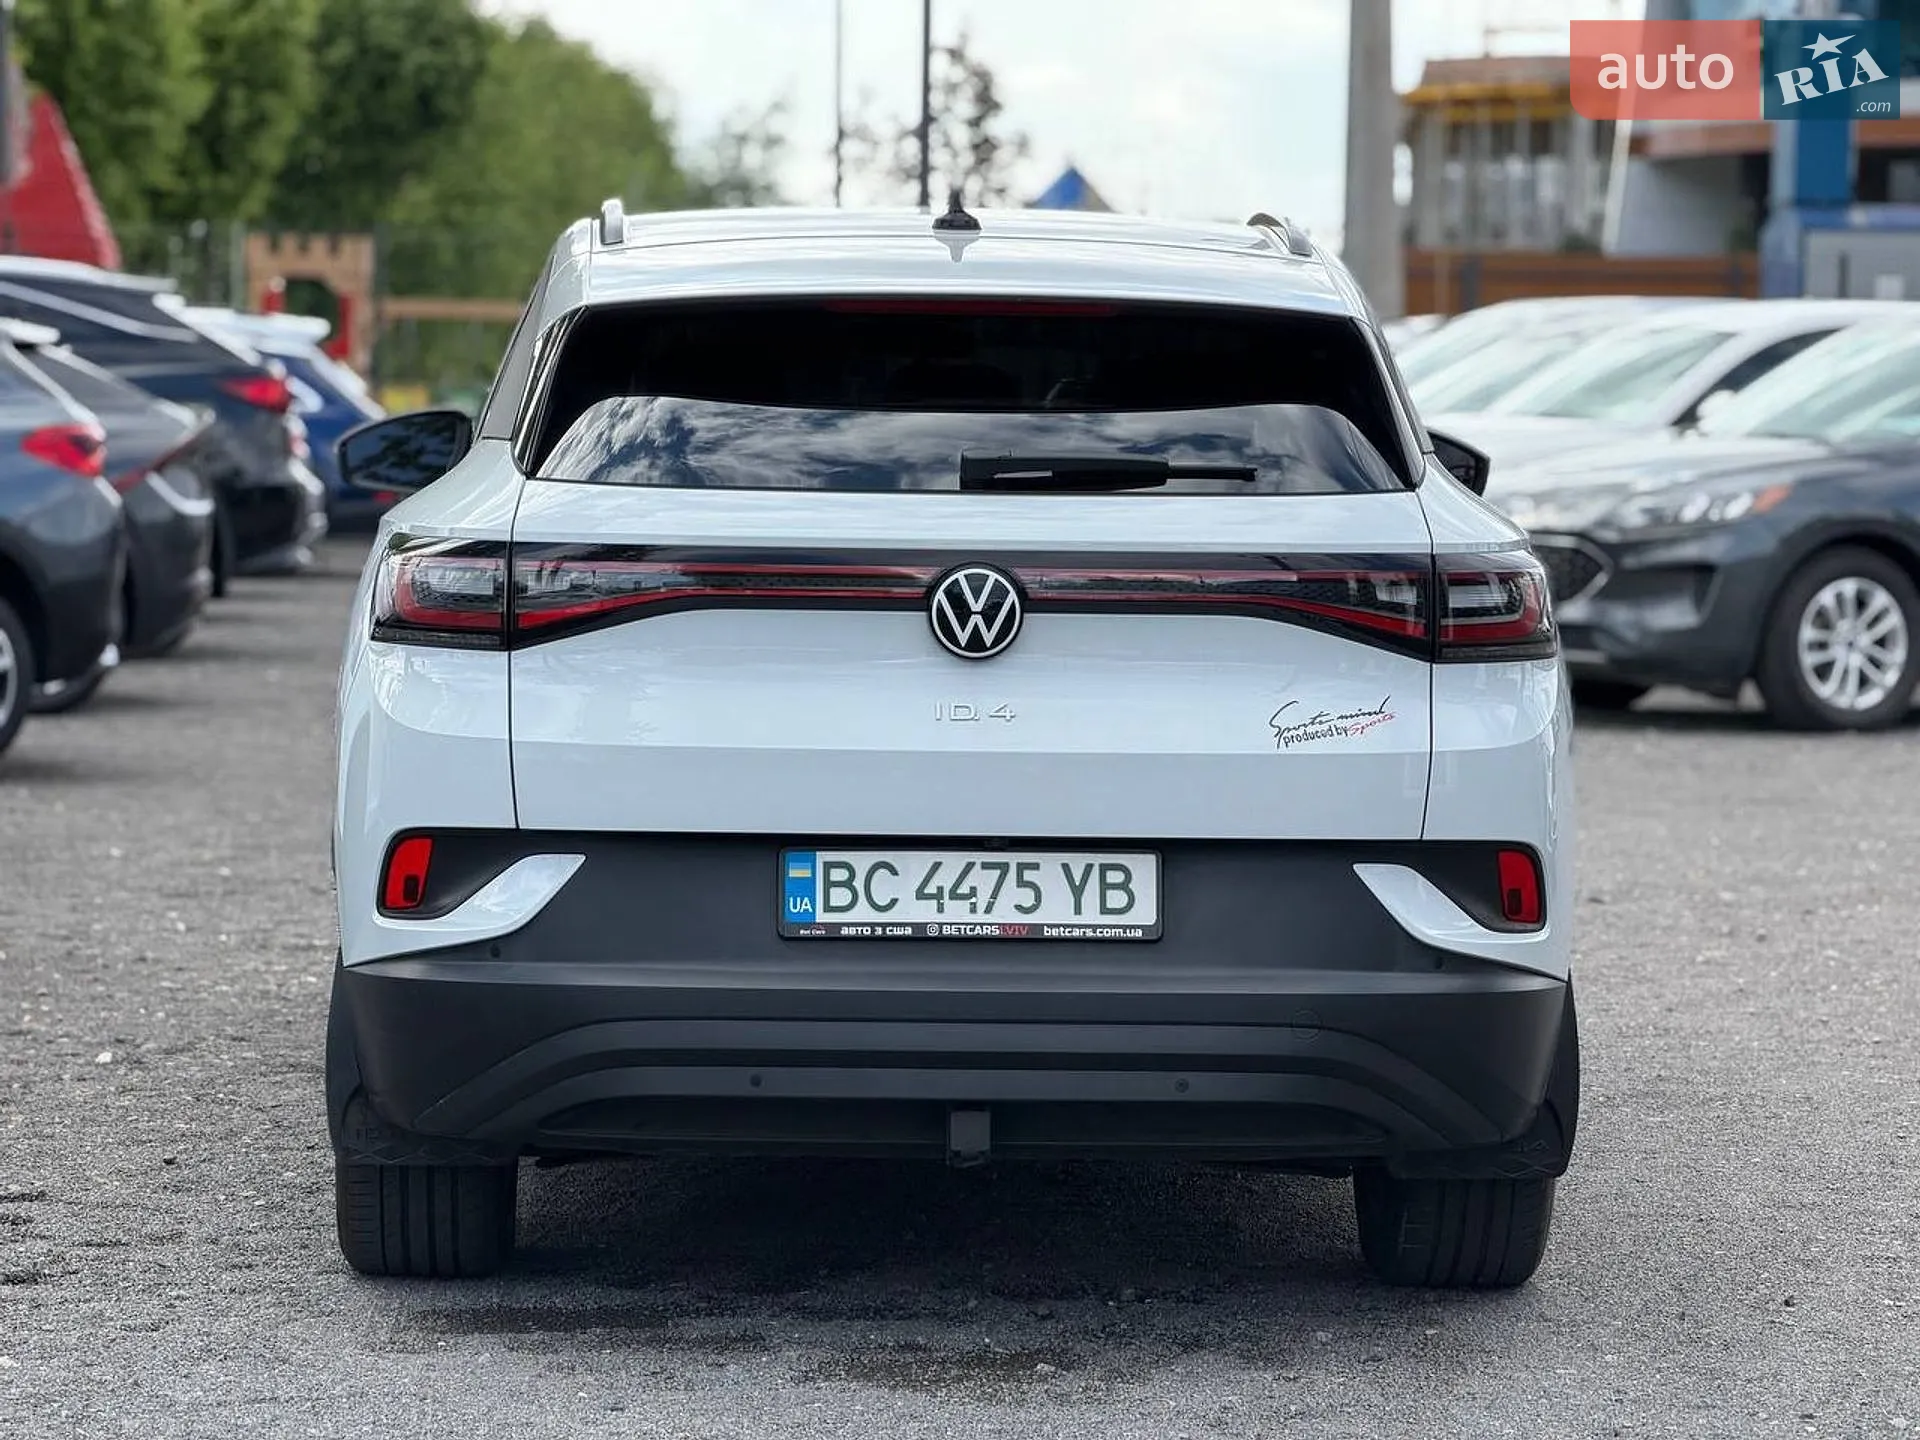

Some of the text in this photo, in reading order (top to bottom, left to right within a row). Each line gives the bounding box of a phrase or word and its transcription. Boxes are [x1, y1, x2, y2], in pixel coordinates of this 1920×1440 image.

[937, 571, 1016, 649] VW
[1283, 726, 1333, 748] produced
[1334, 724, 1349, 738] by
[822, 861, 1136, 916] BC 4475 YB
[789, 897, 812, 913] UA
[1043, 925, 1143, 937] betcars.com.ua
